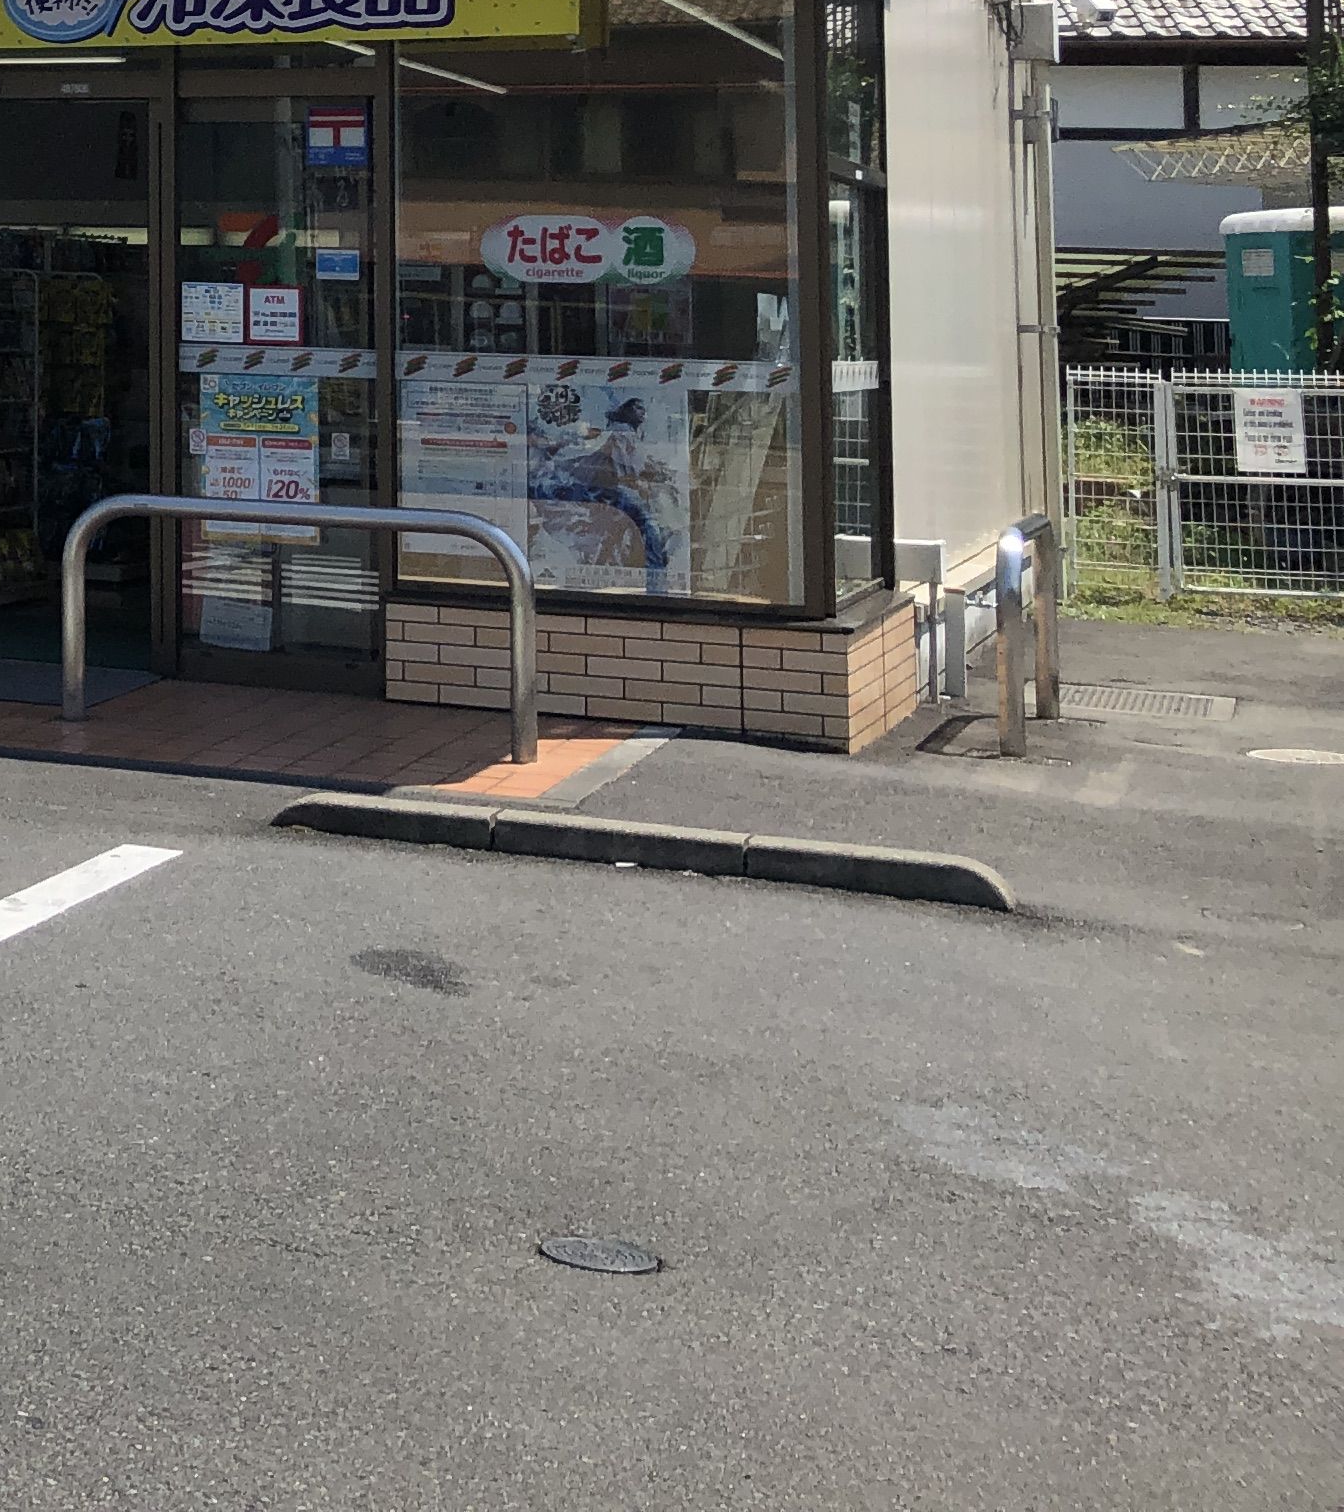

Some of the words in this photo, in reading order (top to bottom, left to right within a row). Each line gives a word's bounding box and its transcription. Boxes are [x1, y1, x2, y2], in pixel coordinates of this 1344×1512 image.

[506, 224, 603, 265] たばこ
[622, 225, 665, 266] 酒
[525, 266, 585, 280] cigarette
[627, 268, 666, 281] liquor
[263, 295, 286, 305] ATM
[213, 392, 305, 410] キャッシュレス
[226, 408, 277, 421] キャンペーン
